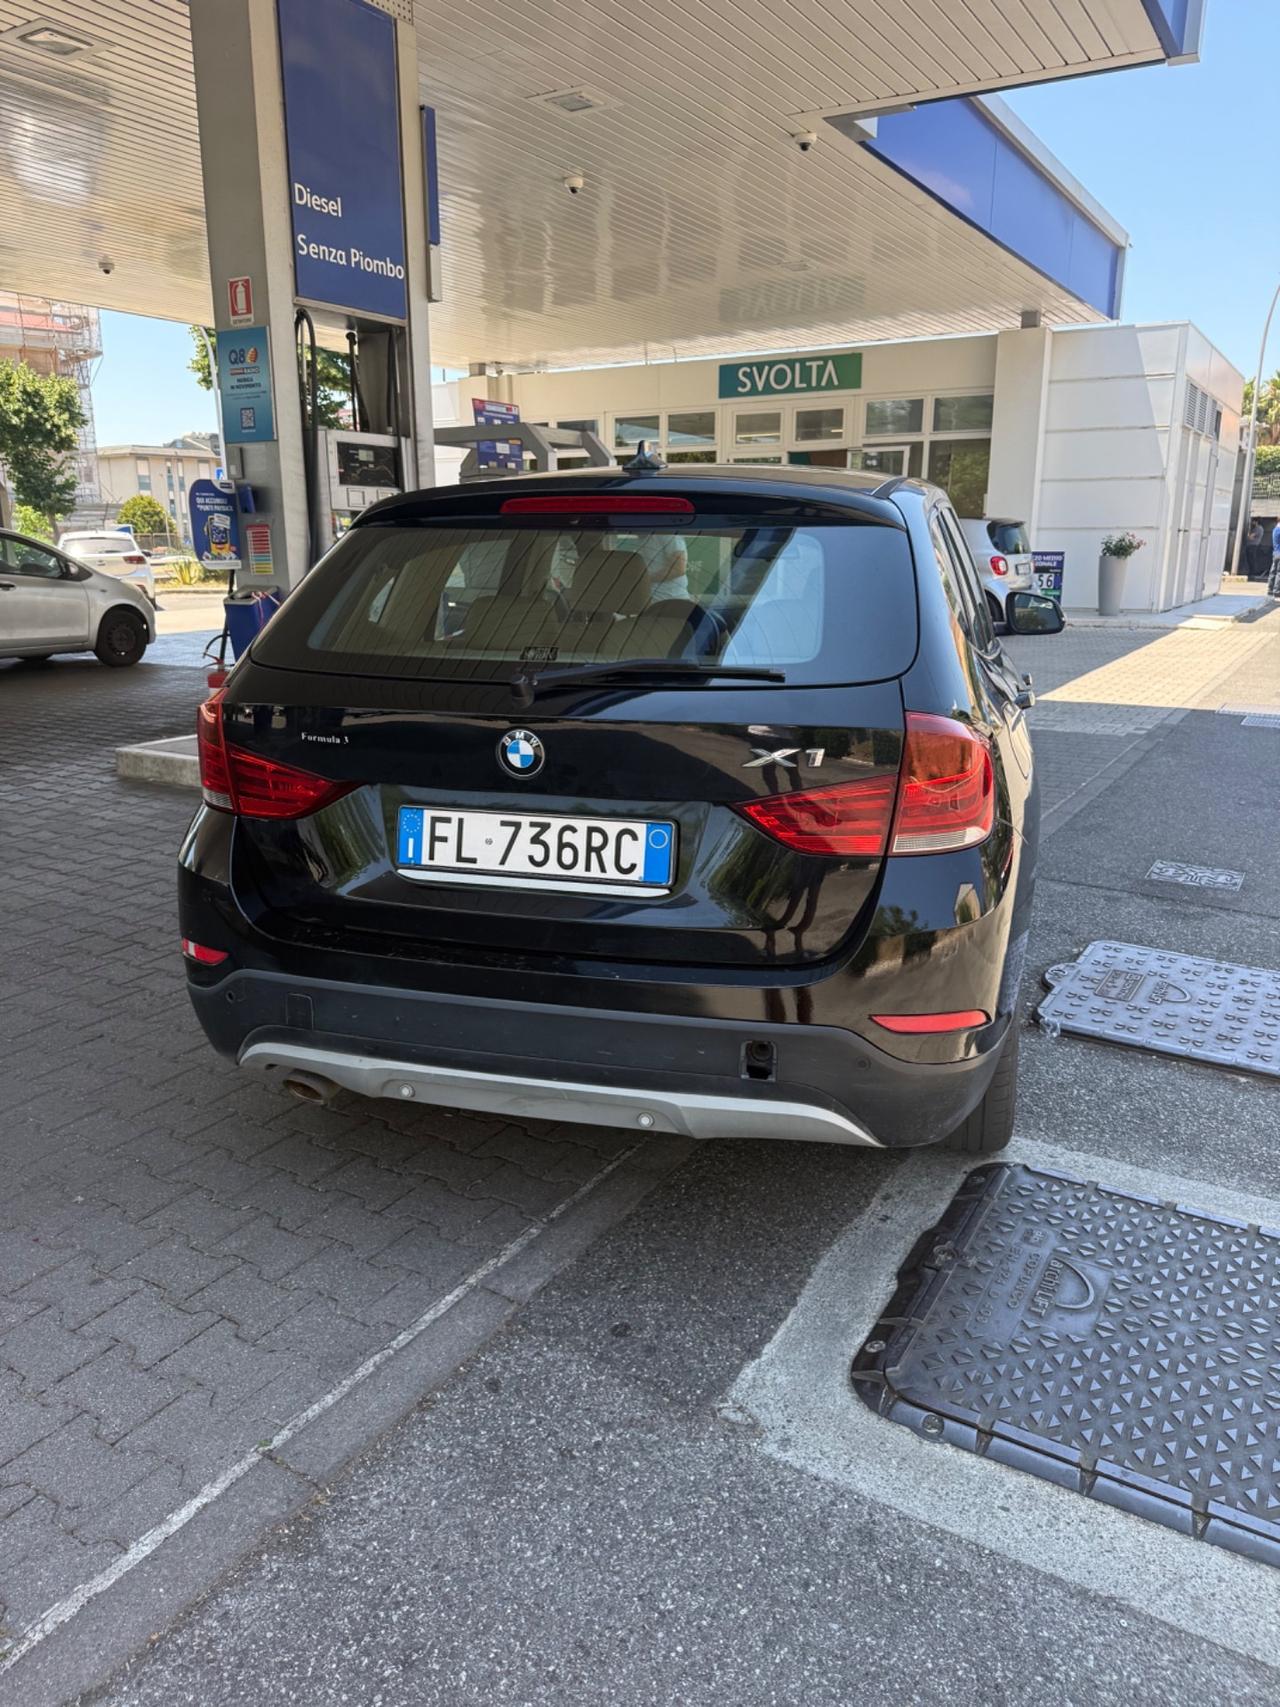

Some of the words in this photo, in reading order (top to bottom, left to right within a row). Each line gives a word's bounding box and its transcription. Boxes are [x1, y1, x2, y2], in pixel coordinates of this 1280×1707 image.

[294, 182, 342, 217] Diesel
[297, 233, 347, 265] Senza
[350, 248, 405, 280] Piombo
[229, 348, 246, 365] Q8
[737, 359, 839, 393] SVOLTA
[301, 731, 341, 744] Formula
[741, 748, 825, 768] X1
[428, 816, 478, 864] FL
[498, 820, 640, 875] 736RC
